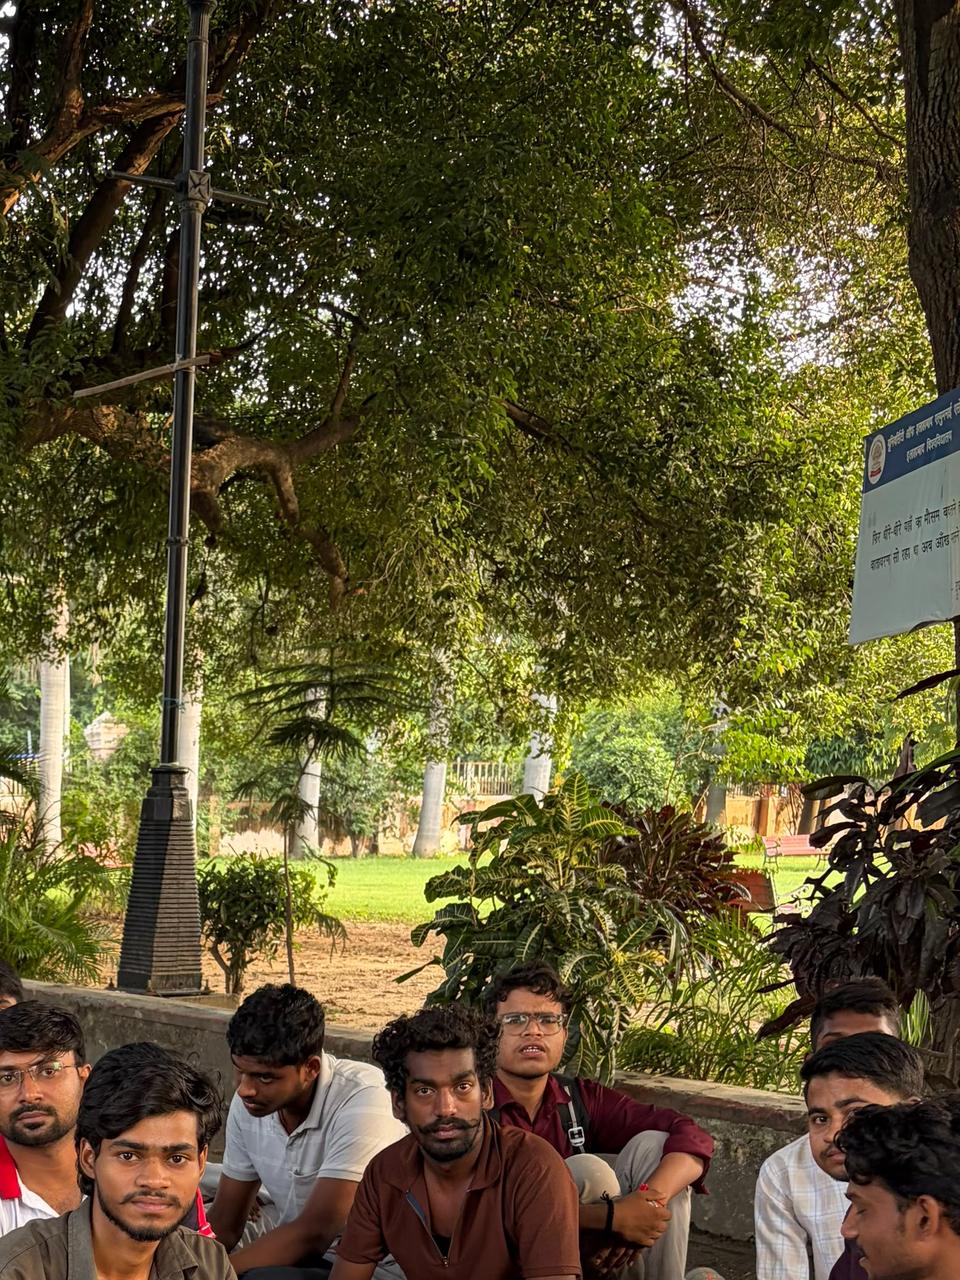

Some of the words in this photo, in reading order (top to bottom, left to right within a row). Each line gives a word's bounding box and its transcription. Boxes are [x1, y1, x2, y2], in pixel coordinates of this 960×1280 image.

[924, 508, 939, 525] मौसम
[902, 547, 910, 561] रहा
[922, 540, 932, 553] अब
[936, 531, 949, 548] आँख
